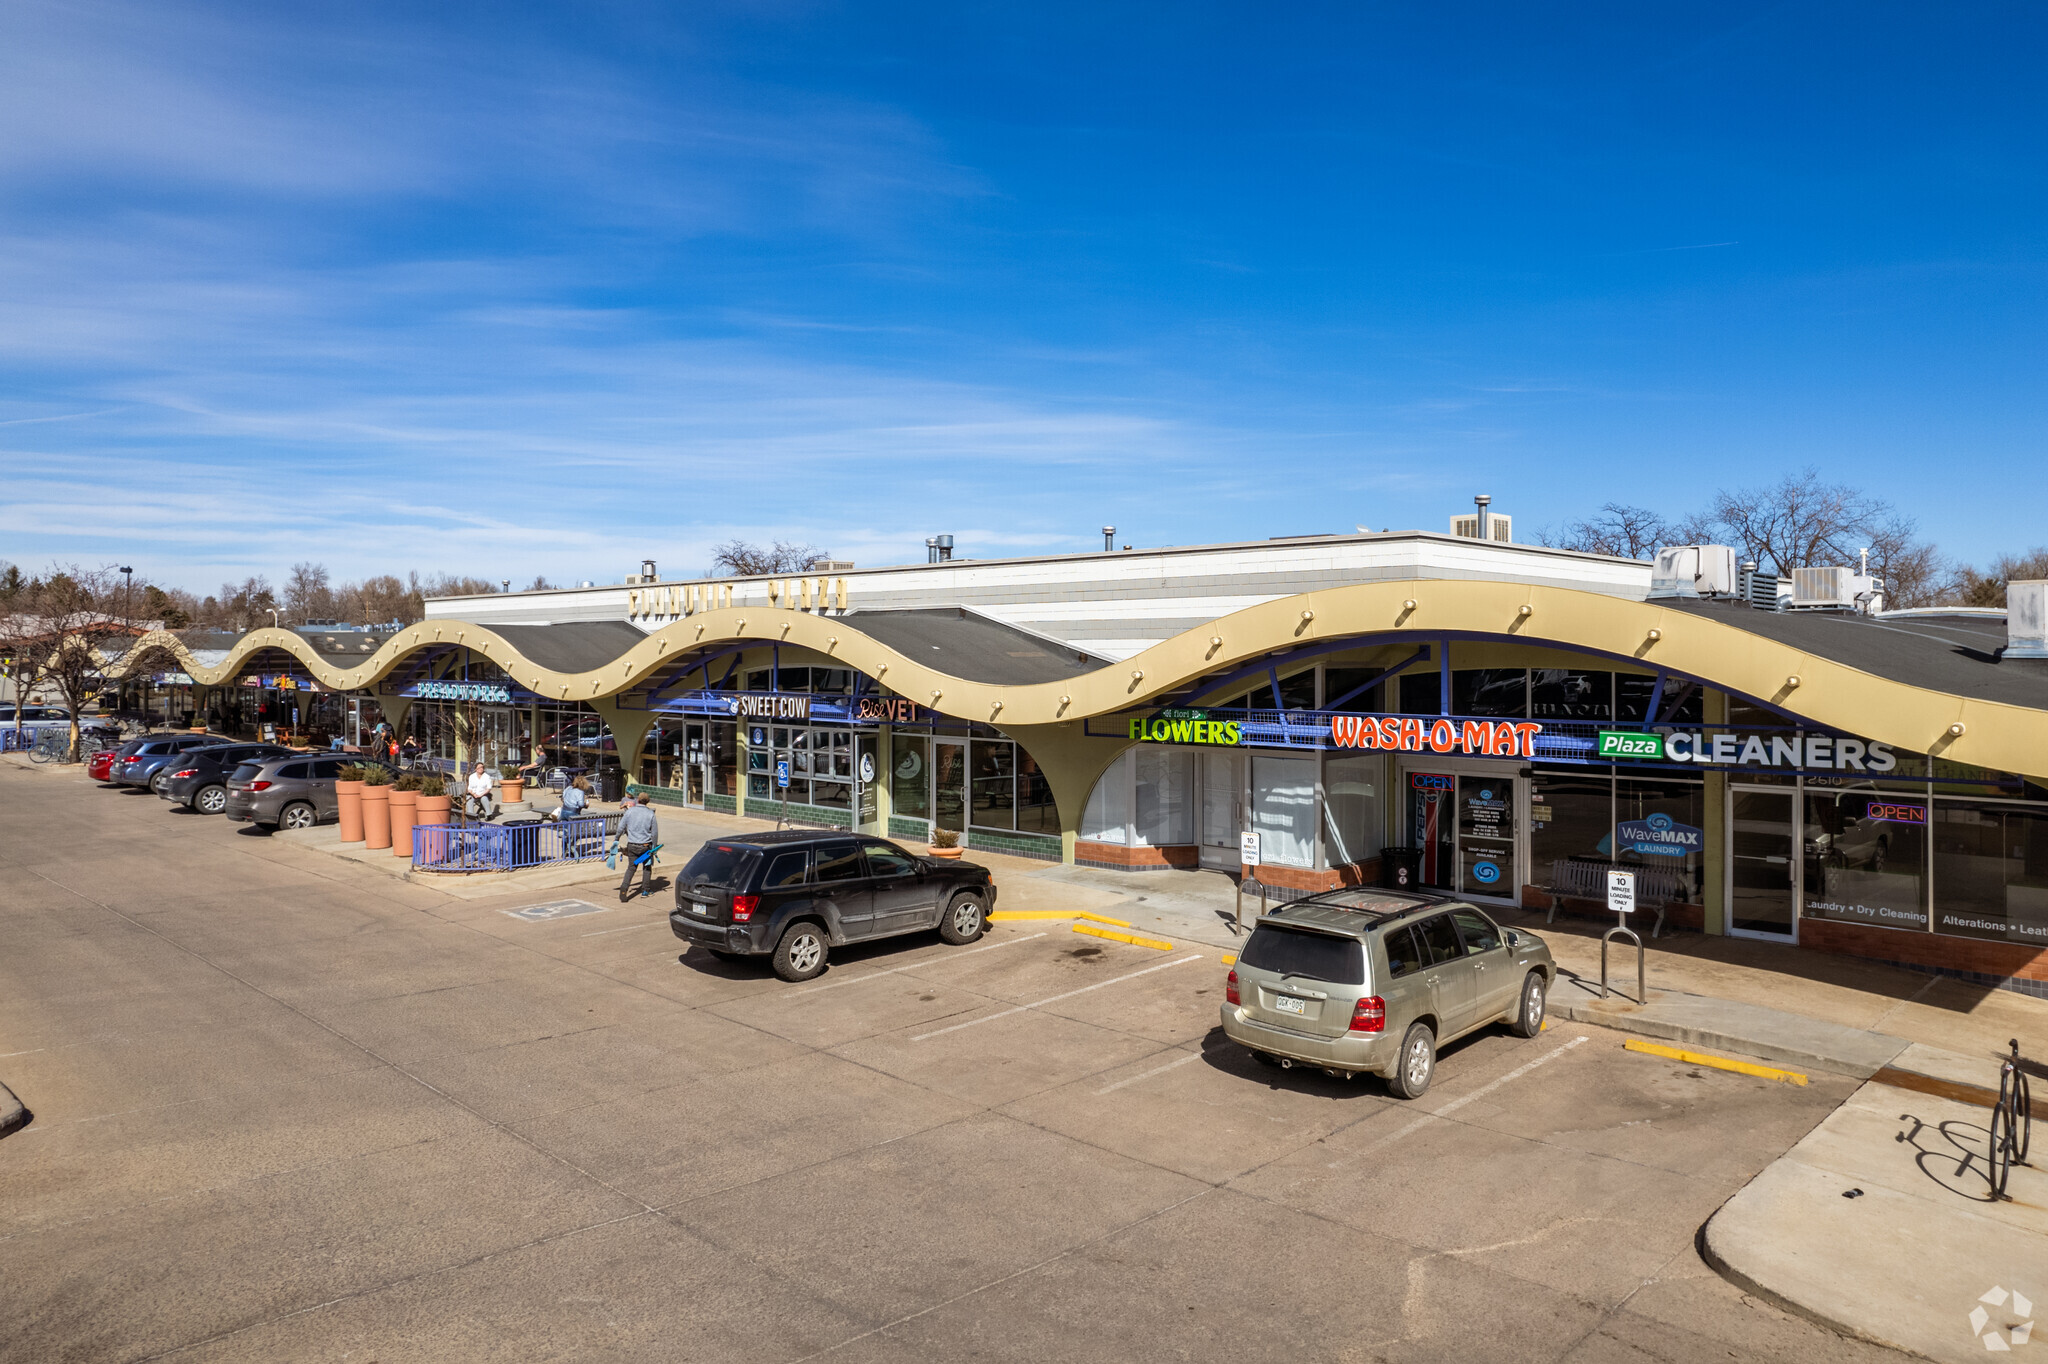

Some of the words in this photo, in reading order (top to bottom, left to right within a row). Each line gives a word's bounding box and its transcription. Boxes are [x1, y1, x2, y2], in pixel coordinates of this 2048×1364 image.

[768, 577, 847, 609] PLAZA
[417, 682, 508, 702] BREADWORKS
[741, 695, 776, 717] SWEET
[780, 698, 806, 718] COW
[857, 698, 886, 719] Rise
[886, 699, 918, 722] VET
[1173, 708, 1190, 718] fiori
[1129, 718, 1240, 745] FLOWERS
[1332, 716, 1542, 757] WASH-O-MAT
[1603, 736, 1657, 754] Plaza
[1665, 732, 1897, 771] CLEANERS
[1414, 774, 1453, 789] OPEN
[1416, 789, 1426, 841] PEPSI
[1869, 804, 1924, 821] OPEN
[1622, 826, 1698, 845] WaveMAX
[1638, 844, 1680, 855] LAUNDRY
[1615, 878, 1626, 886] 10
[1609, 892, 1633, 900] LOADING
[1856, 904, 1875, 917] Dry
[1879, 907, 1927, 923] Cleaning
[1942, 914, 2007, 932] Alterations
[2020, 924, 2048, 936] Leat
